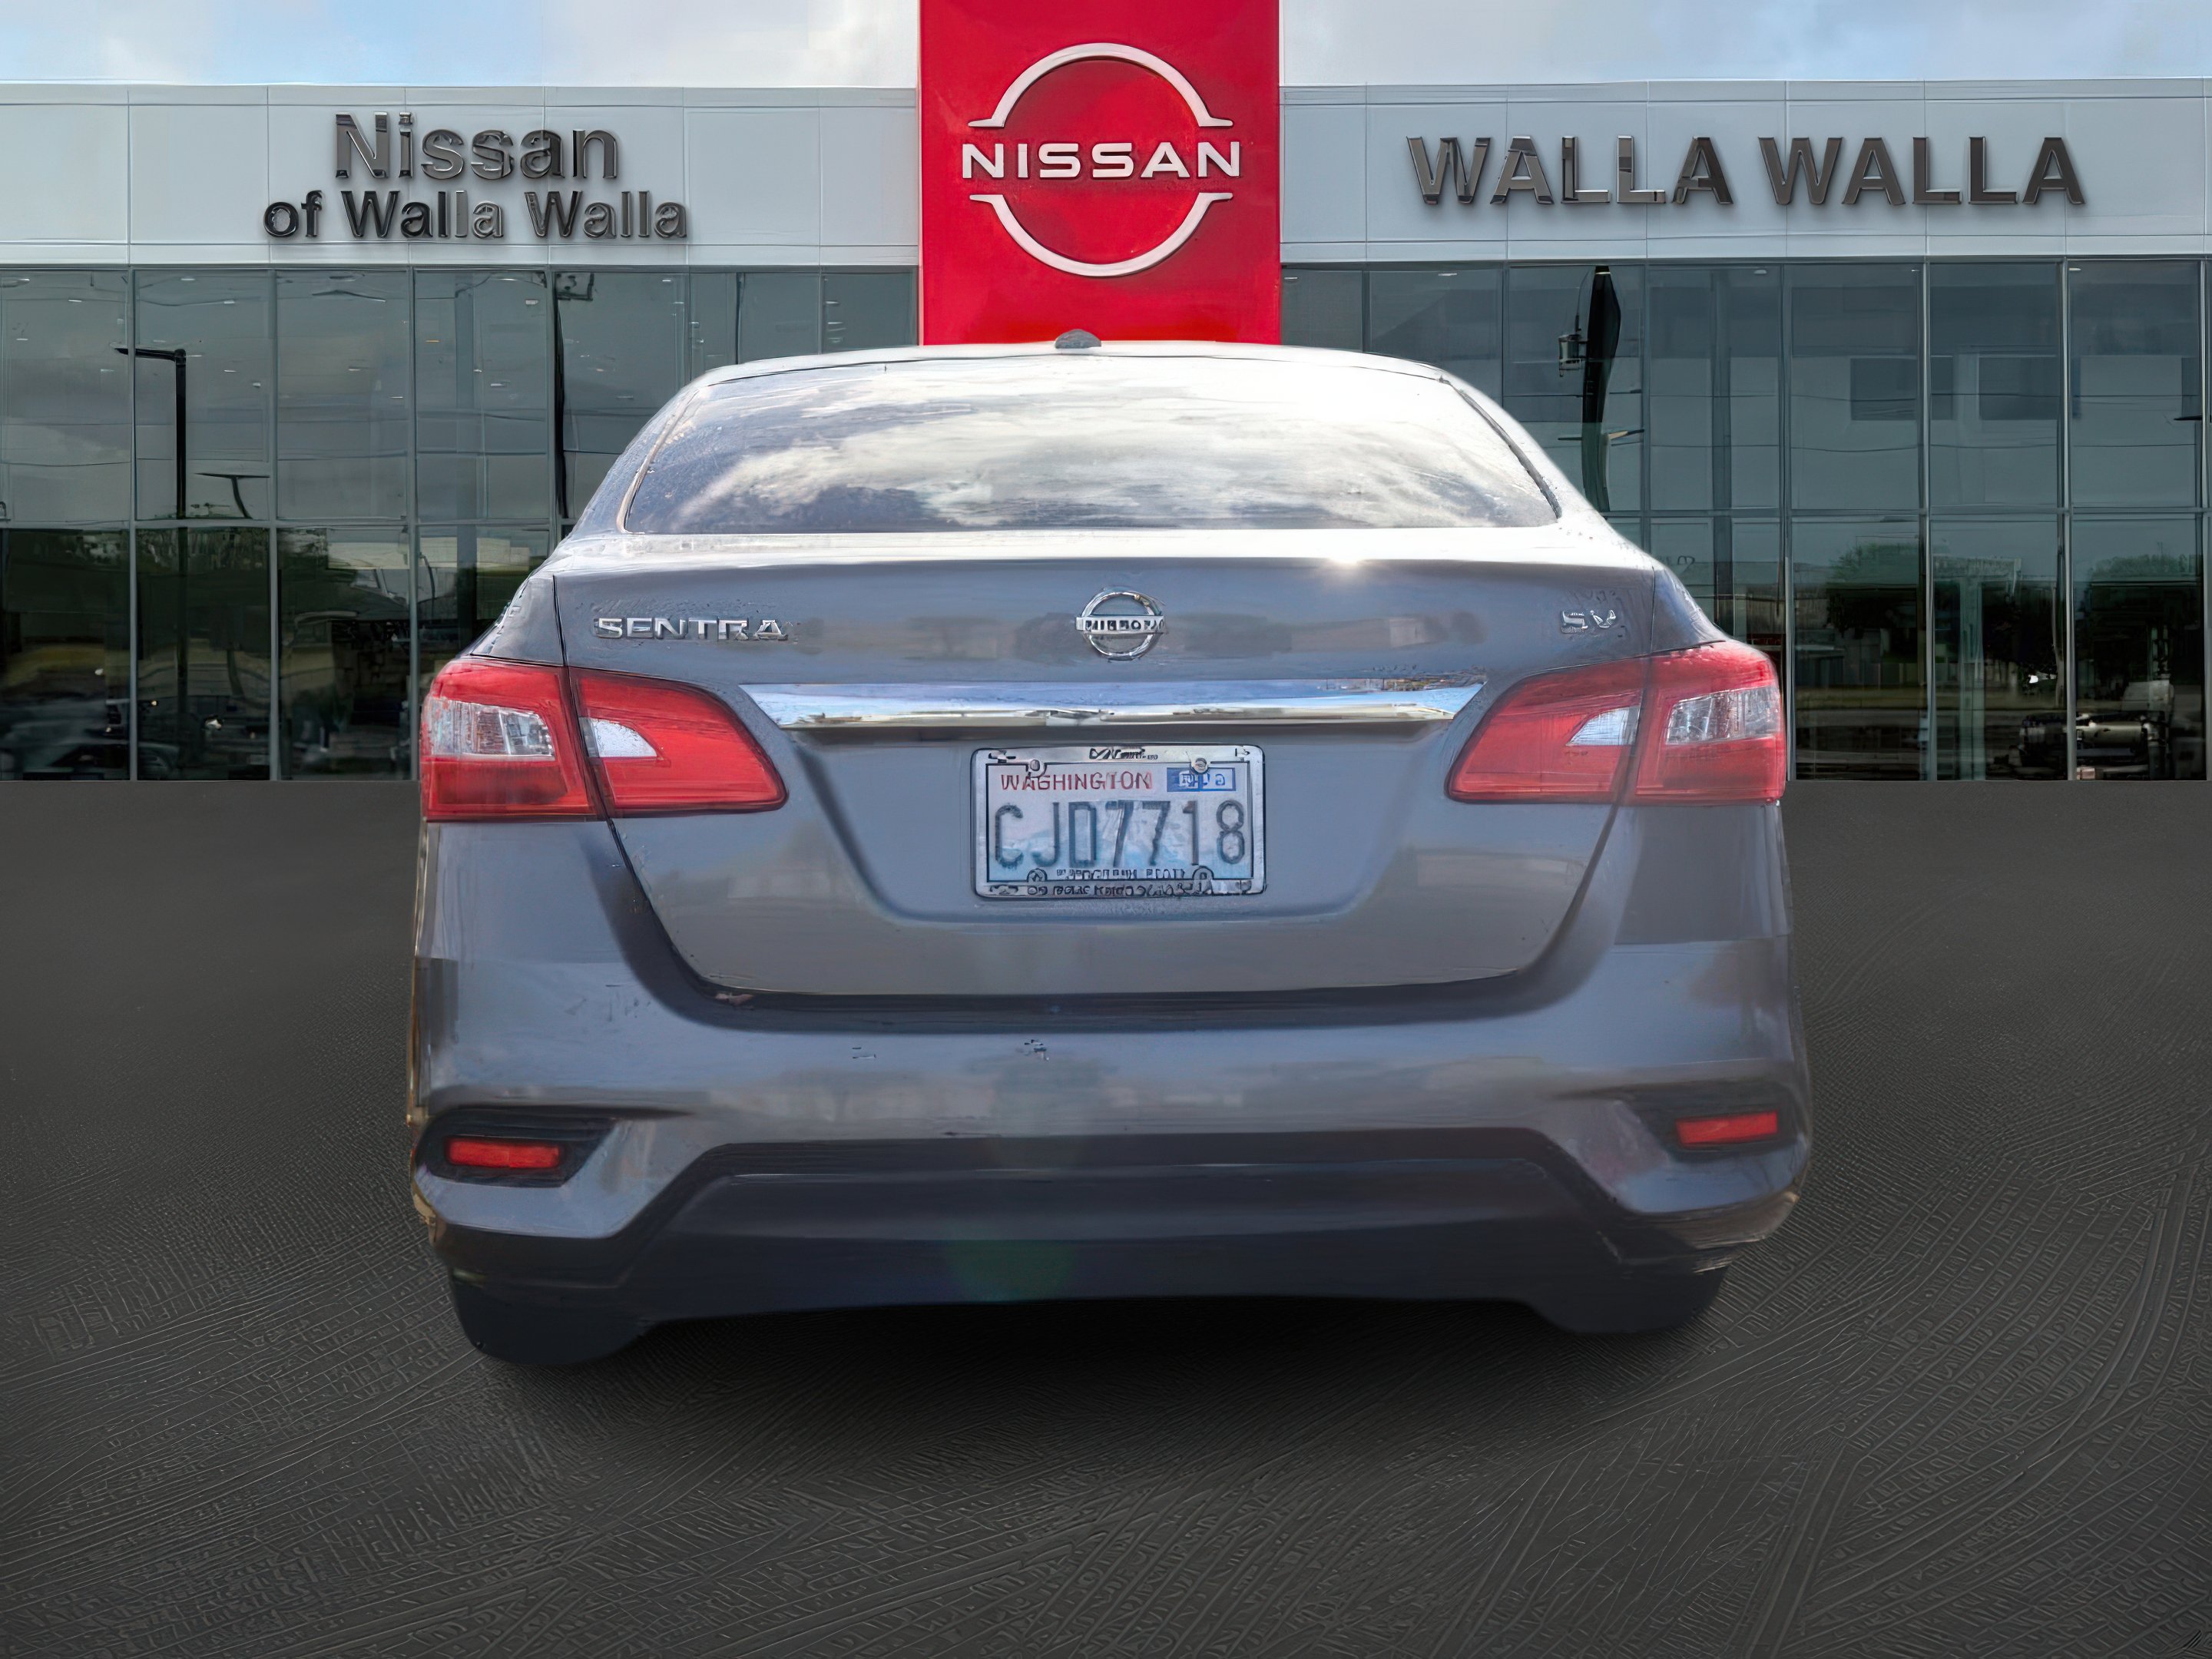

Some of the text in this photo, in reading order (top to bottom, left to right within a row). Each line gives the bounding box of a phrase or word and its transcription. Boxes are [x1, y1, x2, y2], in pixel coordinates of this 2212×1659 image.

[335, 111, 618, 179] Nissan
[962, 141, 1240, 179] NISSAN
[1406, 136, 2087, 206] WALLA WALLA
[263, 189, 688, 239] of Walla Walla
[594, 617, 789, 641] SENTRA
[1001, 770, 1153, 791] WASHINGTON
[994, 798, 1247, 869] CJD7718
